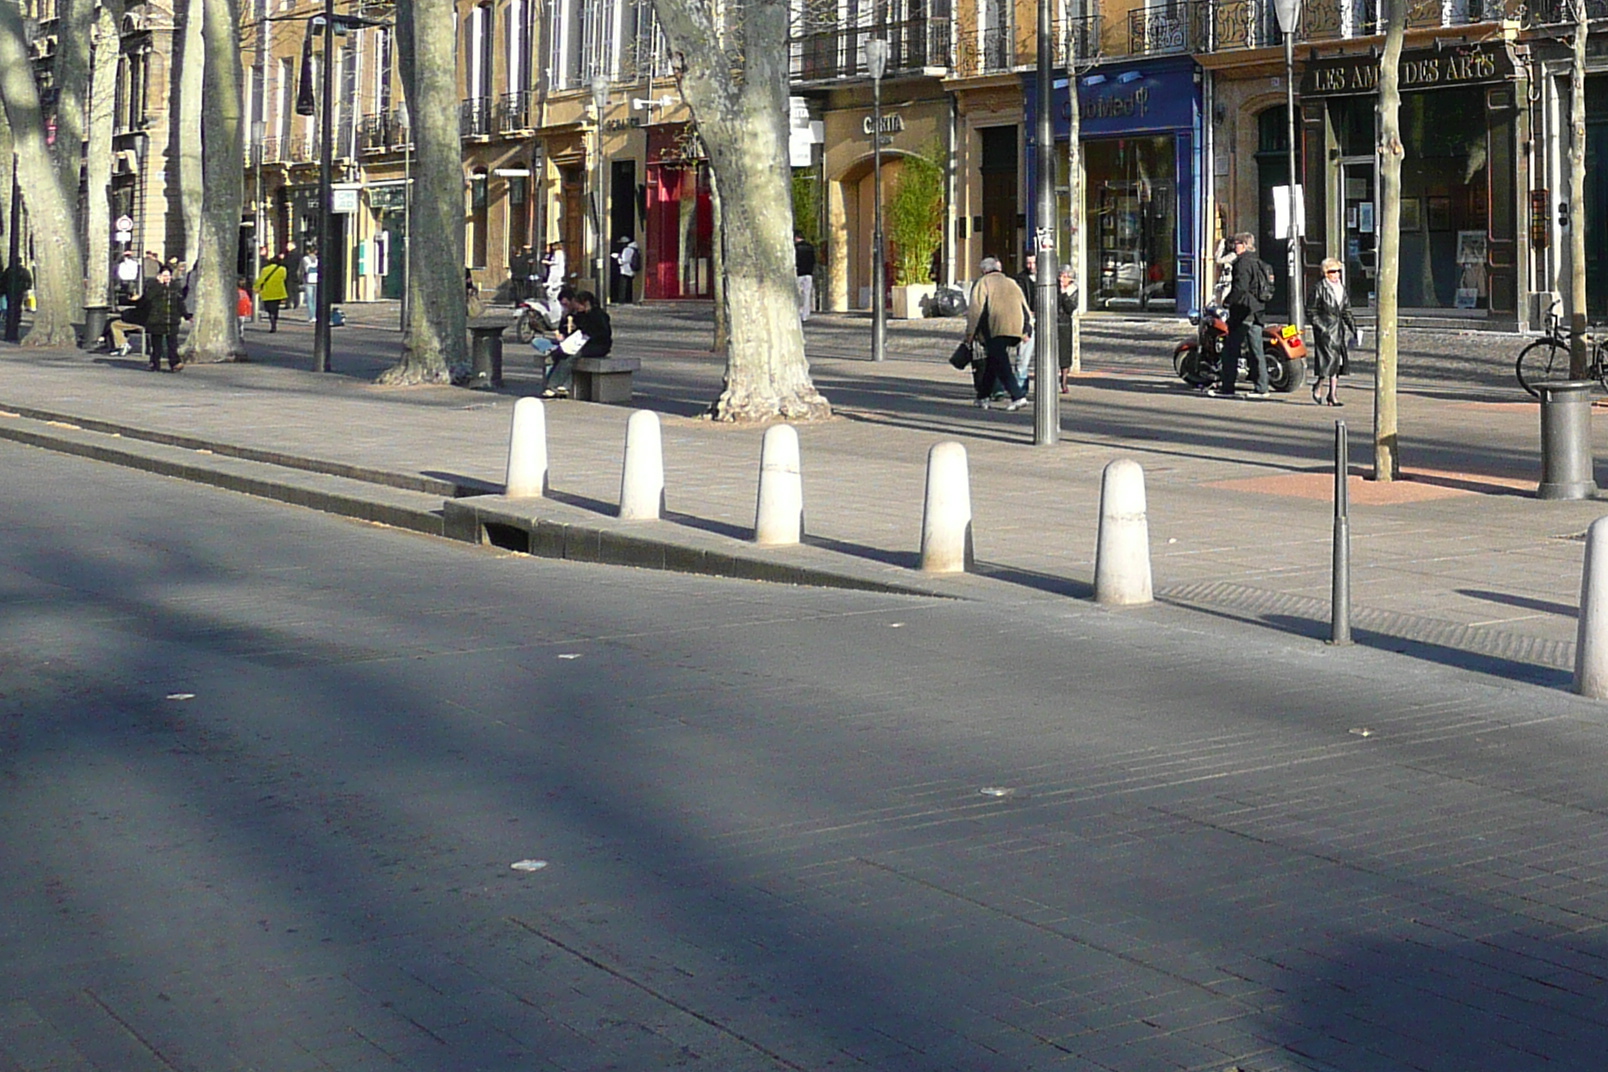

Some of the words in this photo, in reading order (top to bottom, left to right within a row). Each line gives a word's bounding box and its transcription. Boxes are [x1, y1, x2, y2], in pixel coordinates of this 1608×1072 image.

[1314, 67, 1346, 91] LES
[1403, 58, 1440, 84] DES
[1446, 52, 1496, 80] ARTS
[863, 112, 905, 135] CRITA
